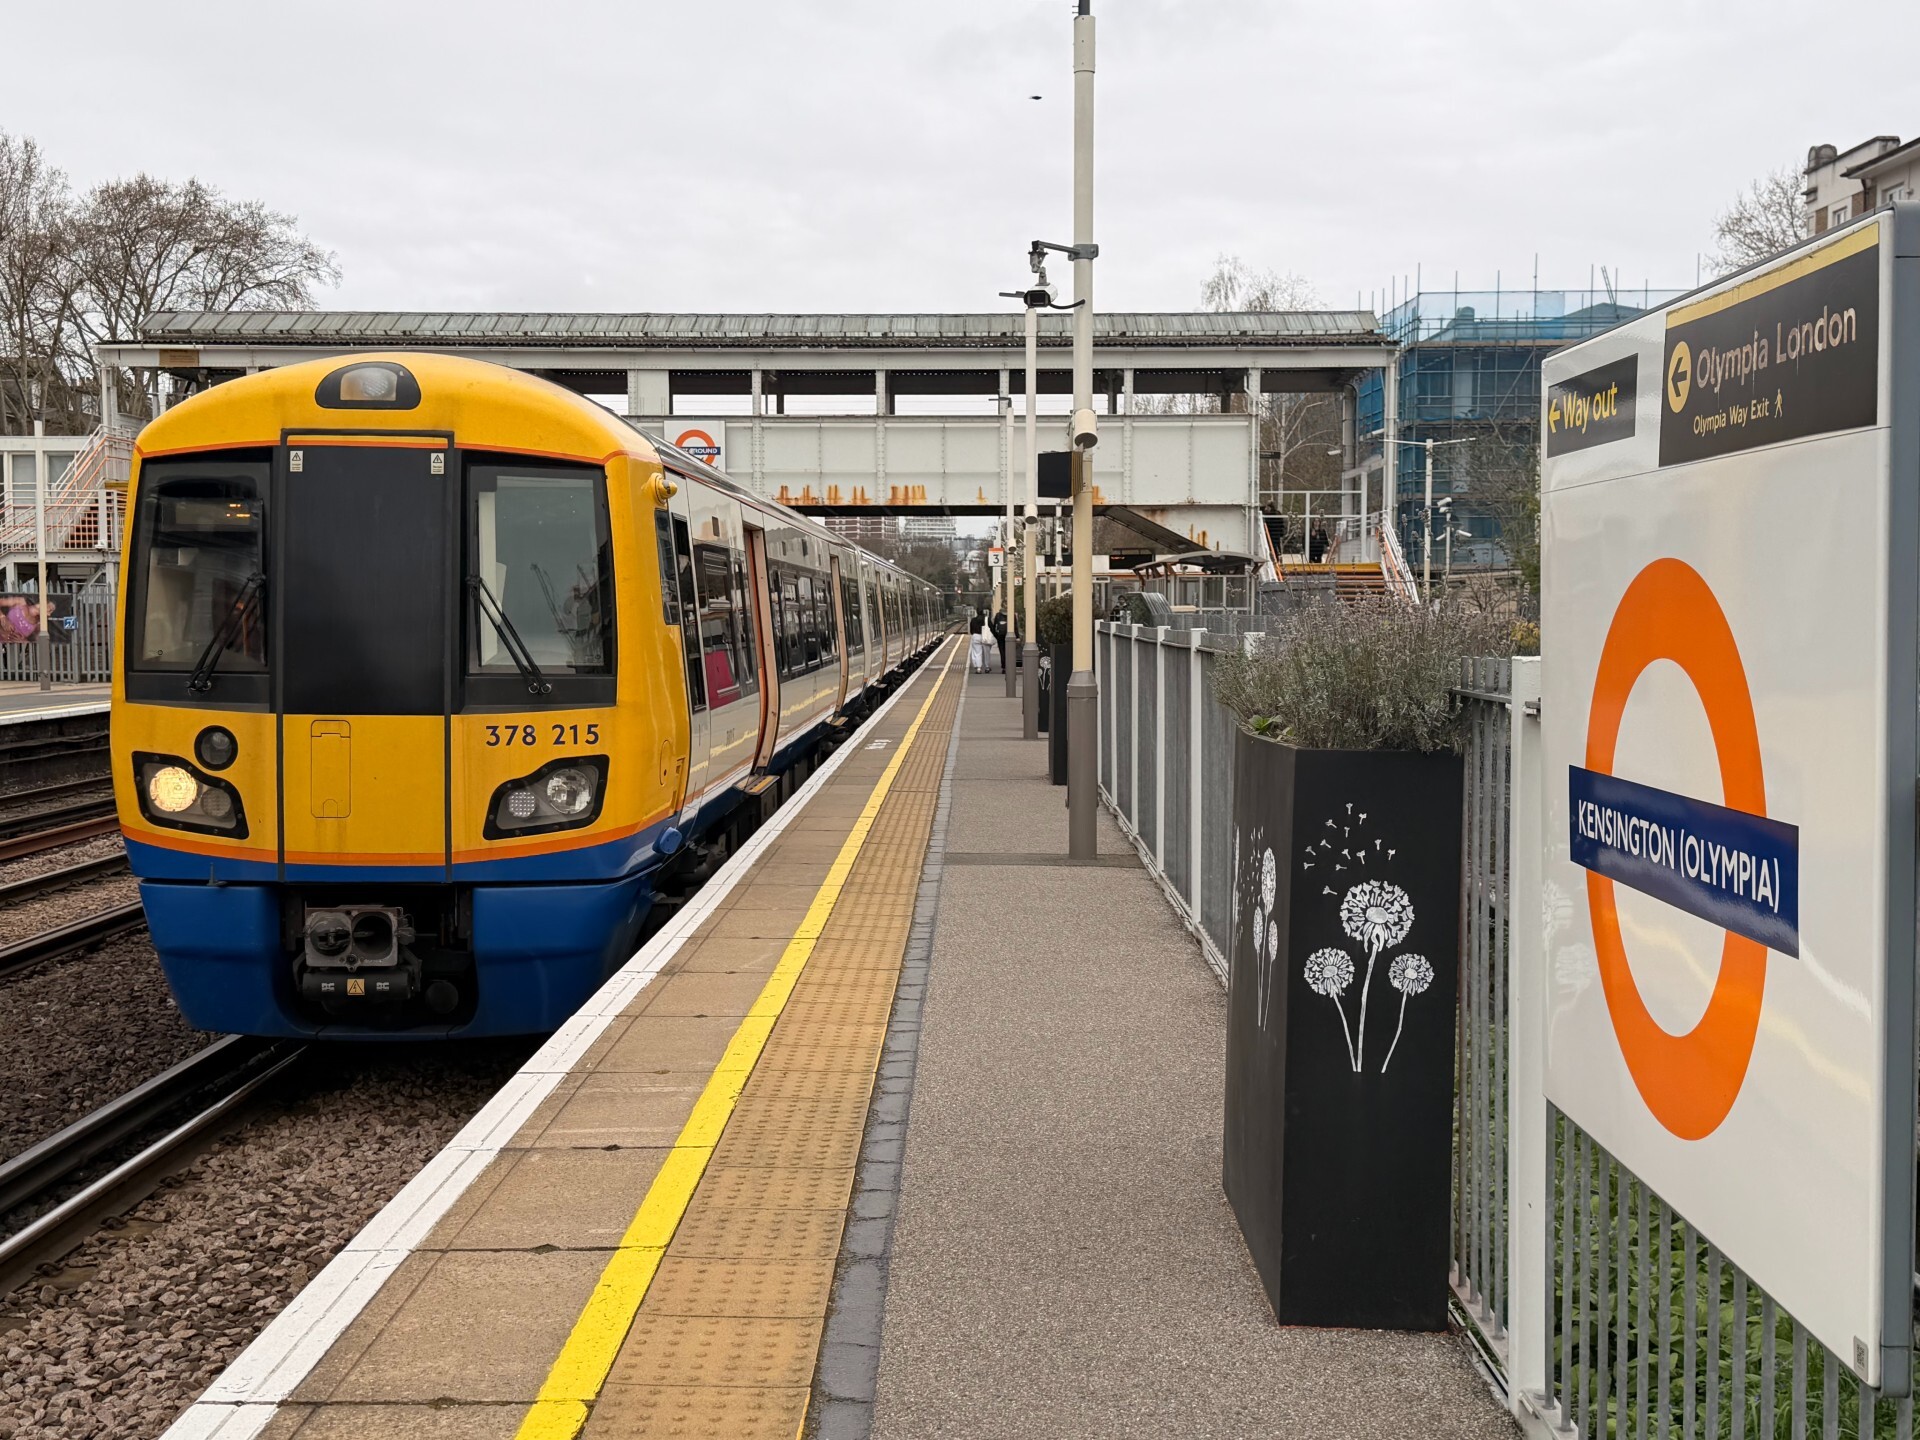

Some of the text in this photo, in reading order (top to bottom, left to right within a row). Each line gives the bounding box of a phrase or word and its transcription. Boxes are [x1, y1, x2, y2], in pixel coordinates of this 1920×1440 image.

[1696, 305, 1857, 394] Olympia London
[1563, 381, 1618, 434] Way out
[1693, 397, 1770, 438] Olympia Way Exit
[992, 554, 1000, 564] 3
[485, 724, 600, 747] 378 215
[1578, 799, 1780, 913] KENSINGTON (OLYMPIA)
